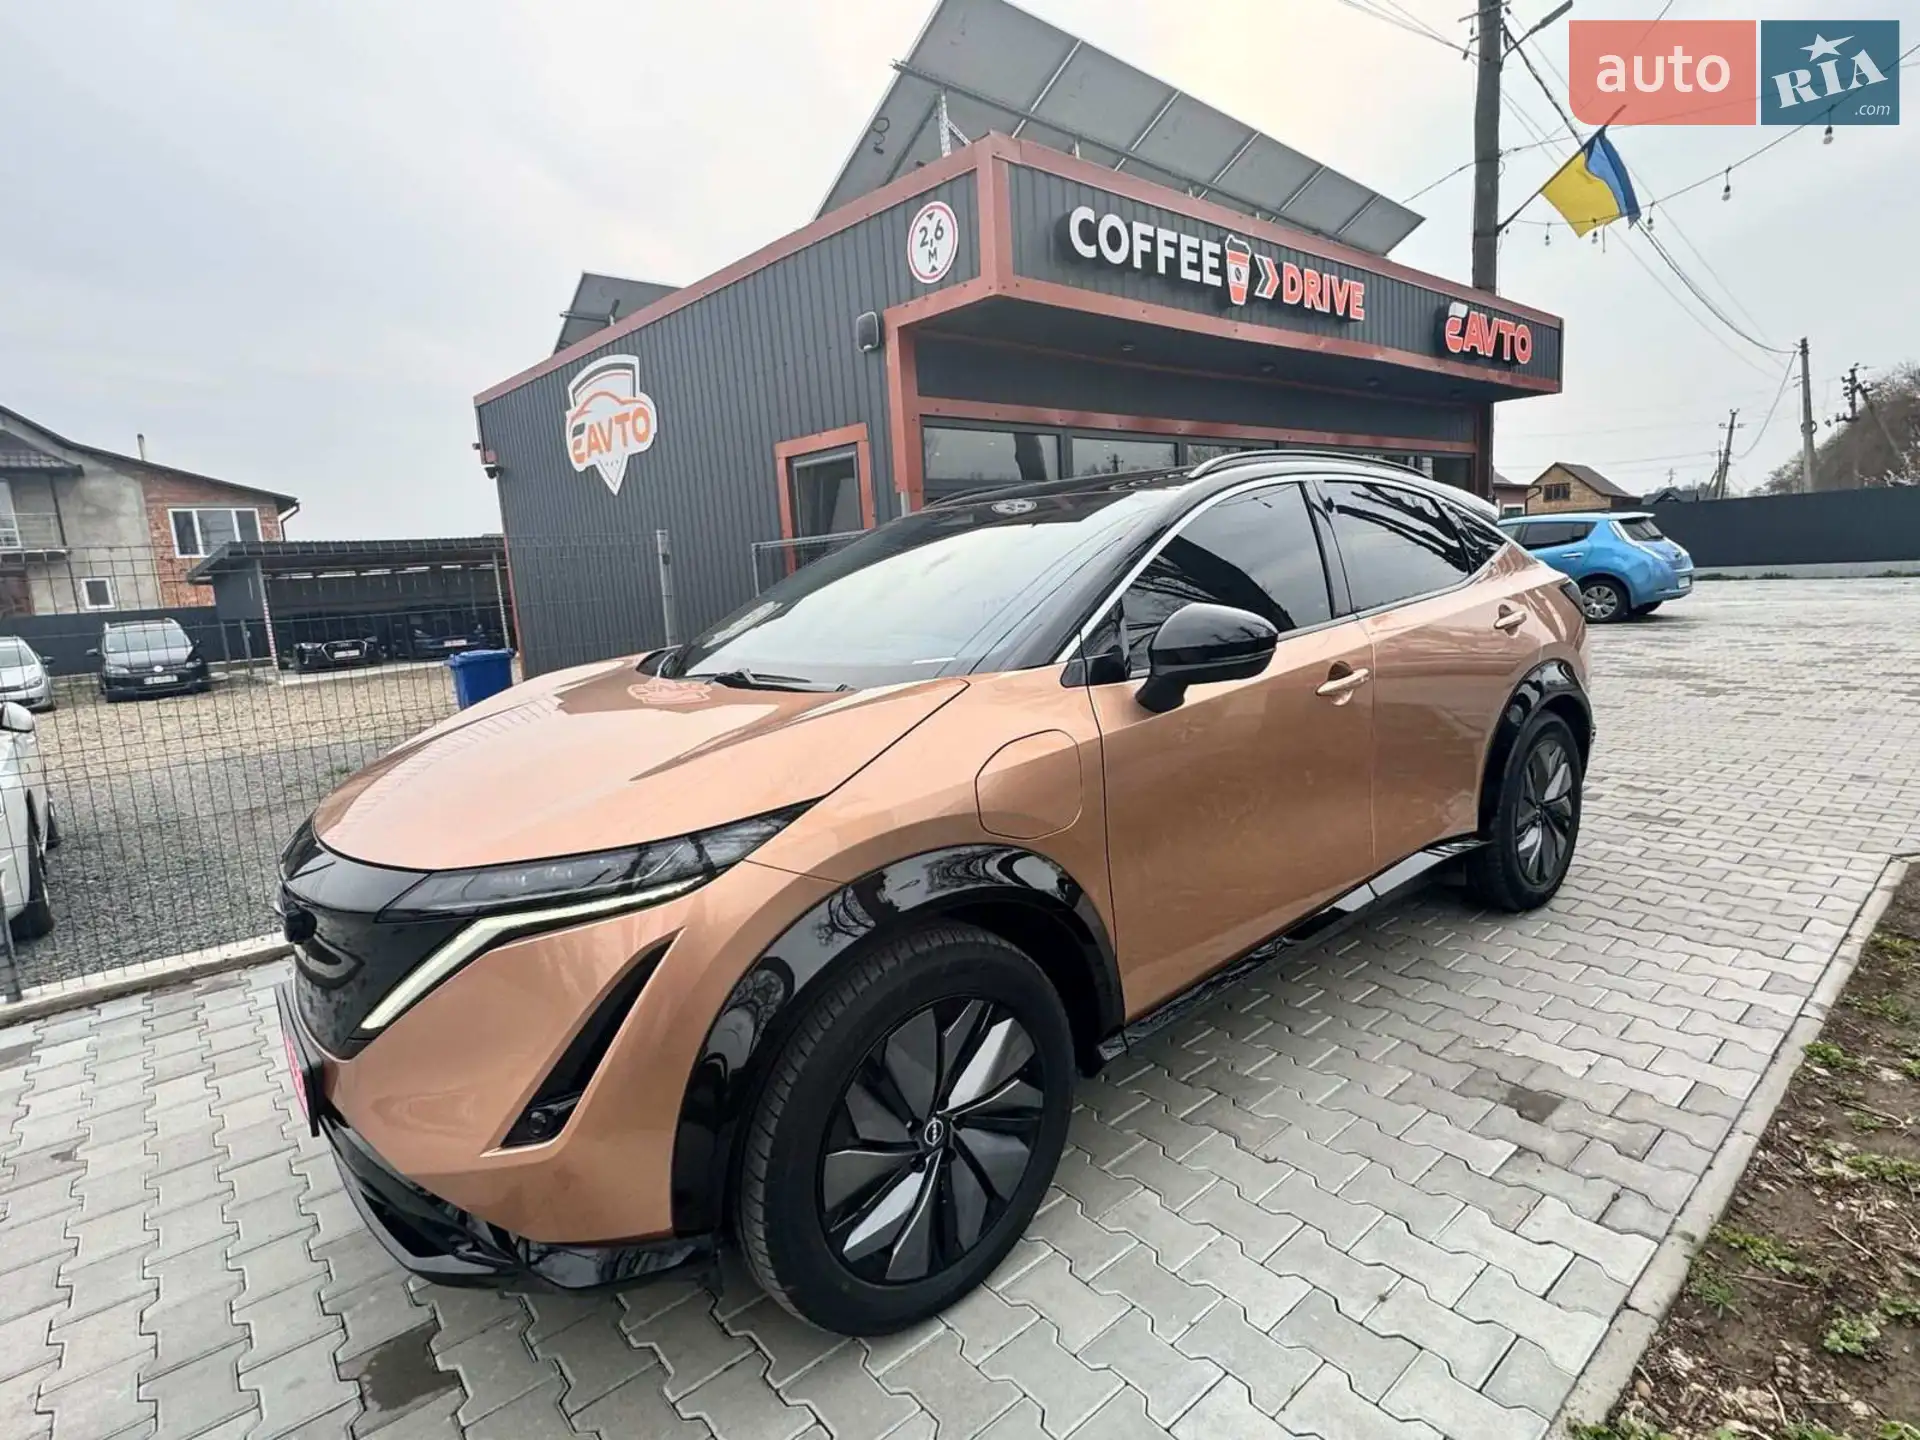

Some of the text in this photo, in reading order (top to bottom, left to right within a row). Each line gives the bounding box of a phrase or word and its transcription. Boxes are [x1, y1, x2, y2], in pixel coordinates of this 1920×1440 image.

[919, 218, 944, 248] 2,6
[1069, 205, 1365, 320] COFFEE DRIVE
